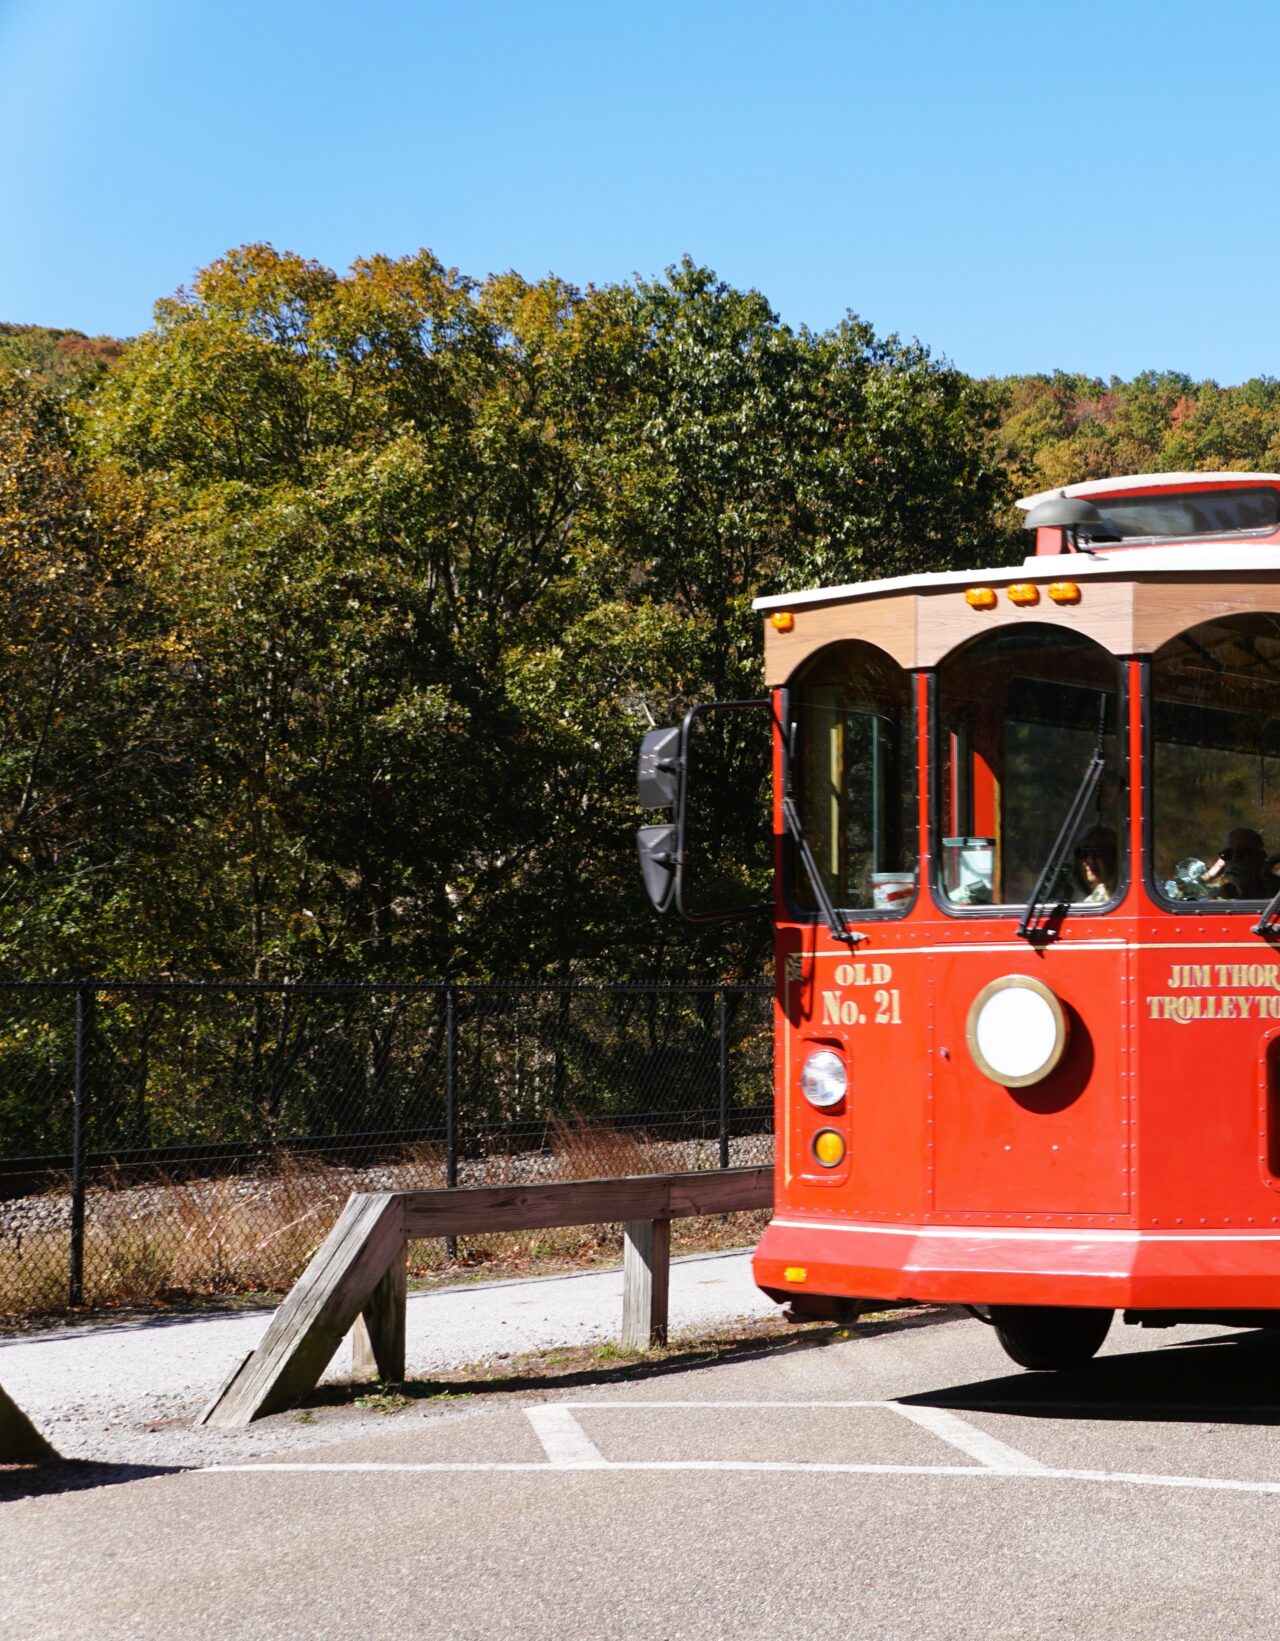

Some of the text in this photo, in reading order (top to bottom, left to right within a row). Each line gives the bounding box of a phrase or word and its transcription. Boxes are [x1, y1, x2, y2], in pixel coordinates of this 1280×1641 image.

[834, 963, 892, 986] OLD
[1168, 964, 1212, 988] JIM
[821, 989, 902, 1025] No. 21
[1146, 995, 1255, 1024] TROLLEY
